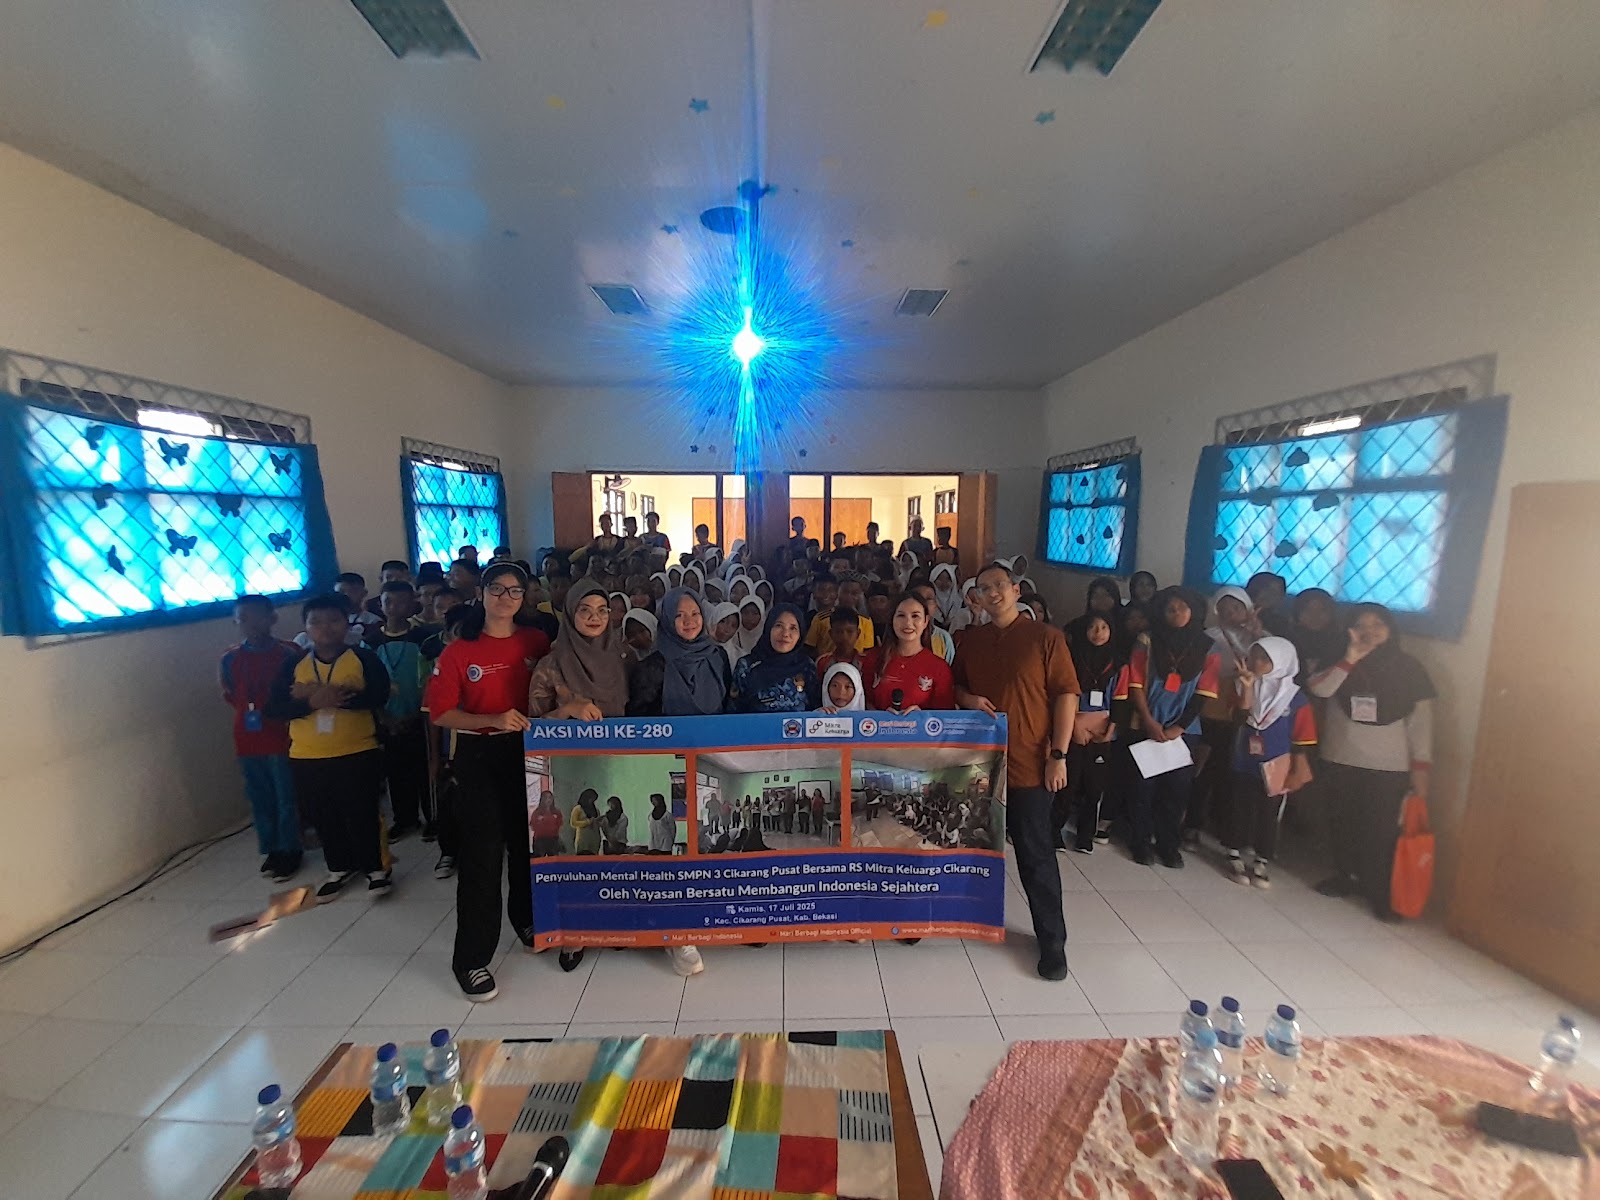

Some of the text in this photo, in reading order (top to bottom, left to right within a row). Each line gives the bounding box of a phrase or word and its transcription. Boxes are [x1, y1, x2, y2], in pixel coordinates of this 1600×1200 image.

[532, 723, 673, 739] AKSI MBI KE-280
[535, 862, 990, 883] Penyuluhan Mental Health SMPN 3 Cikarang Pusat Bersama RS Mitra Keluarga Cikarang
[599, 880, 940, 902] Oleh Yayasan Bersatu Membangun Indonesia Sejahtera
[768, 904, 778, 912] 17
[780, 903, 795, 911] Juli
[796, 902, 816, 910] 2025
[733, 917, 767, 925] Cikarang
[812, 912, 838, 921] Bekasi
